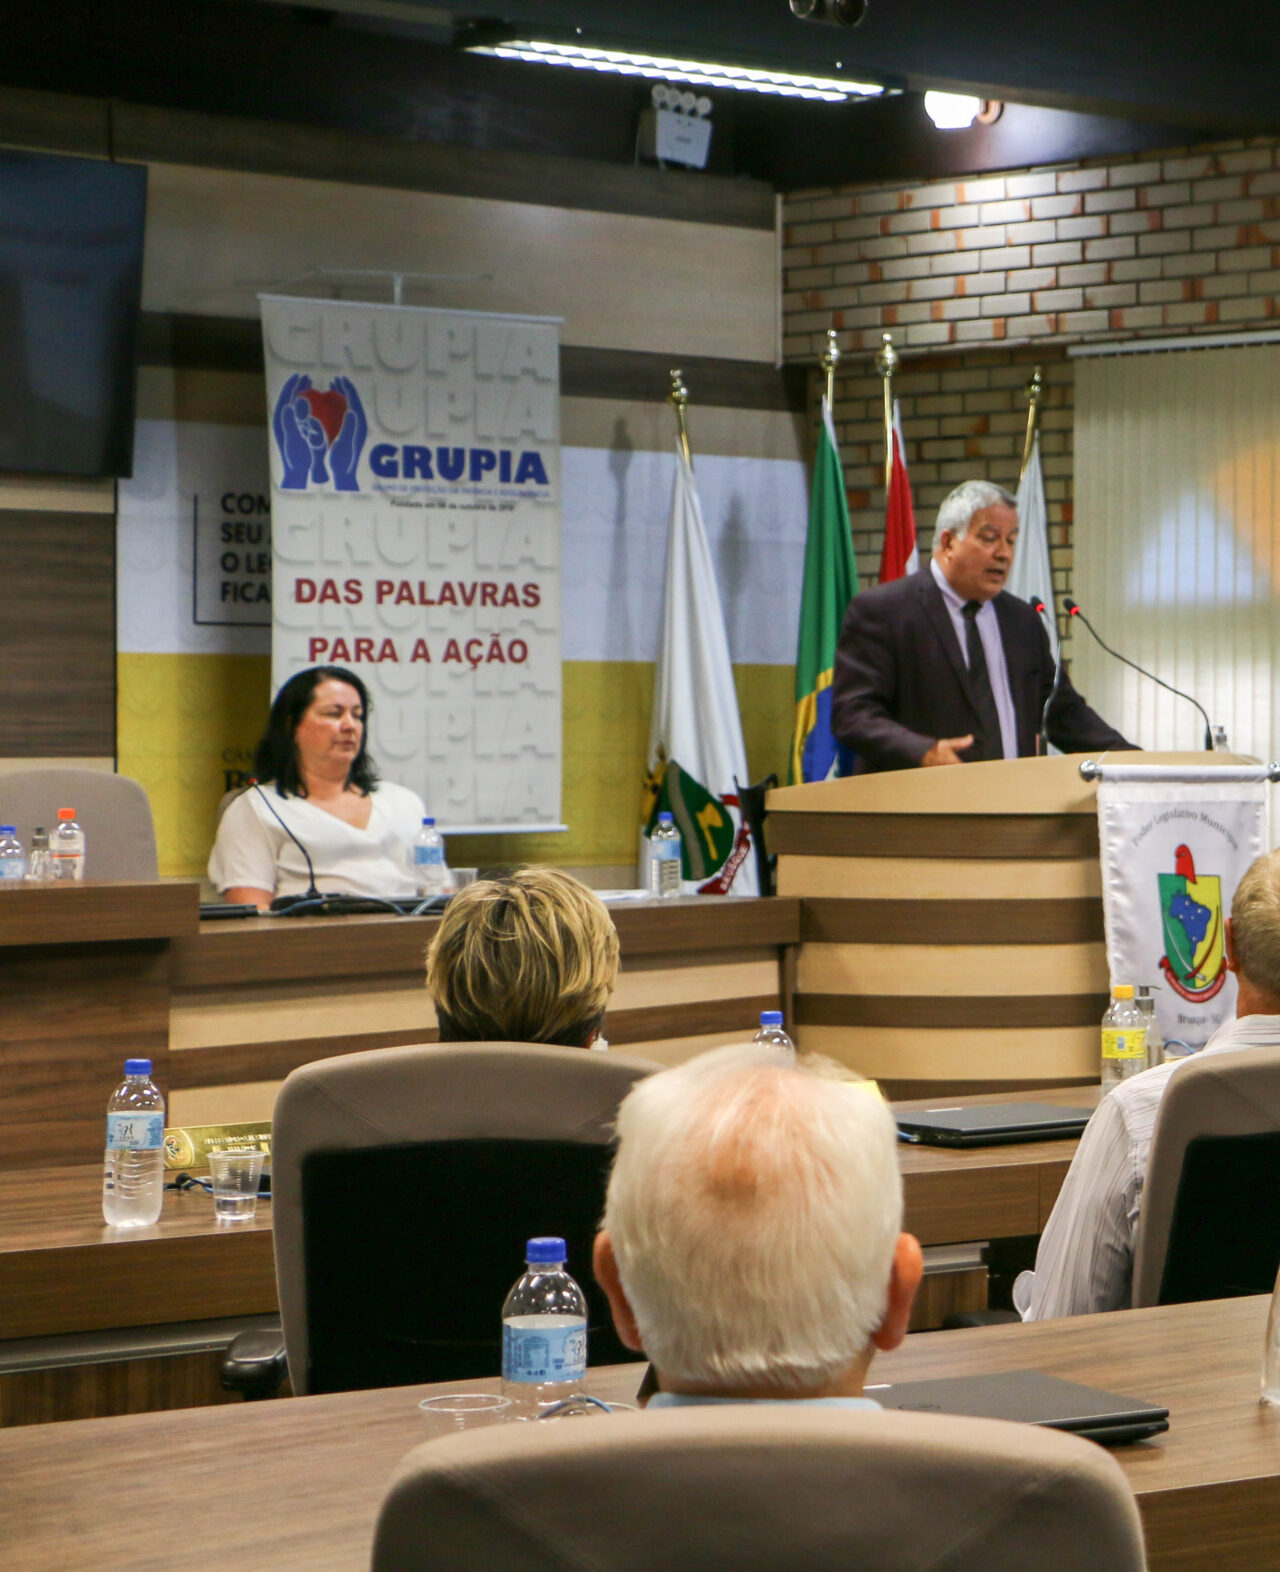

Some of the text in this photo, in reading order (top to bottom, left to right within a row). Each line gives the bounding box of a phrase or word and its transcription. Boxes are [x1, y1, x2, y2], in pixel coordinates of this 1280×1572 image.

[369, 443, 550, 486] GRUPIA
[221, 522, 262, 544] SEU
[221, 552, 271, 574] O LE
[294, 577, 542, 608] DAS PALAVRAS
[308, 632, 529, 671] PARA A AÇÃO
